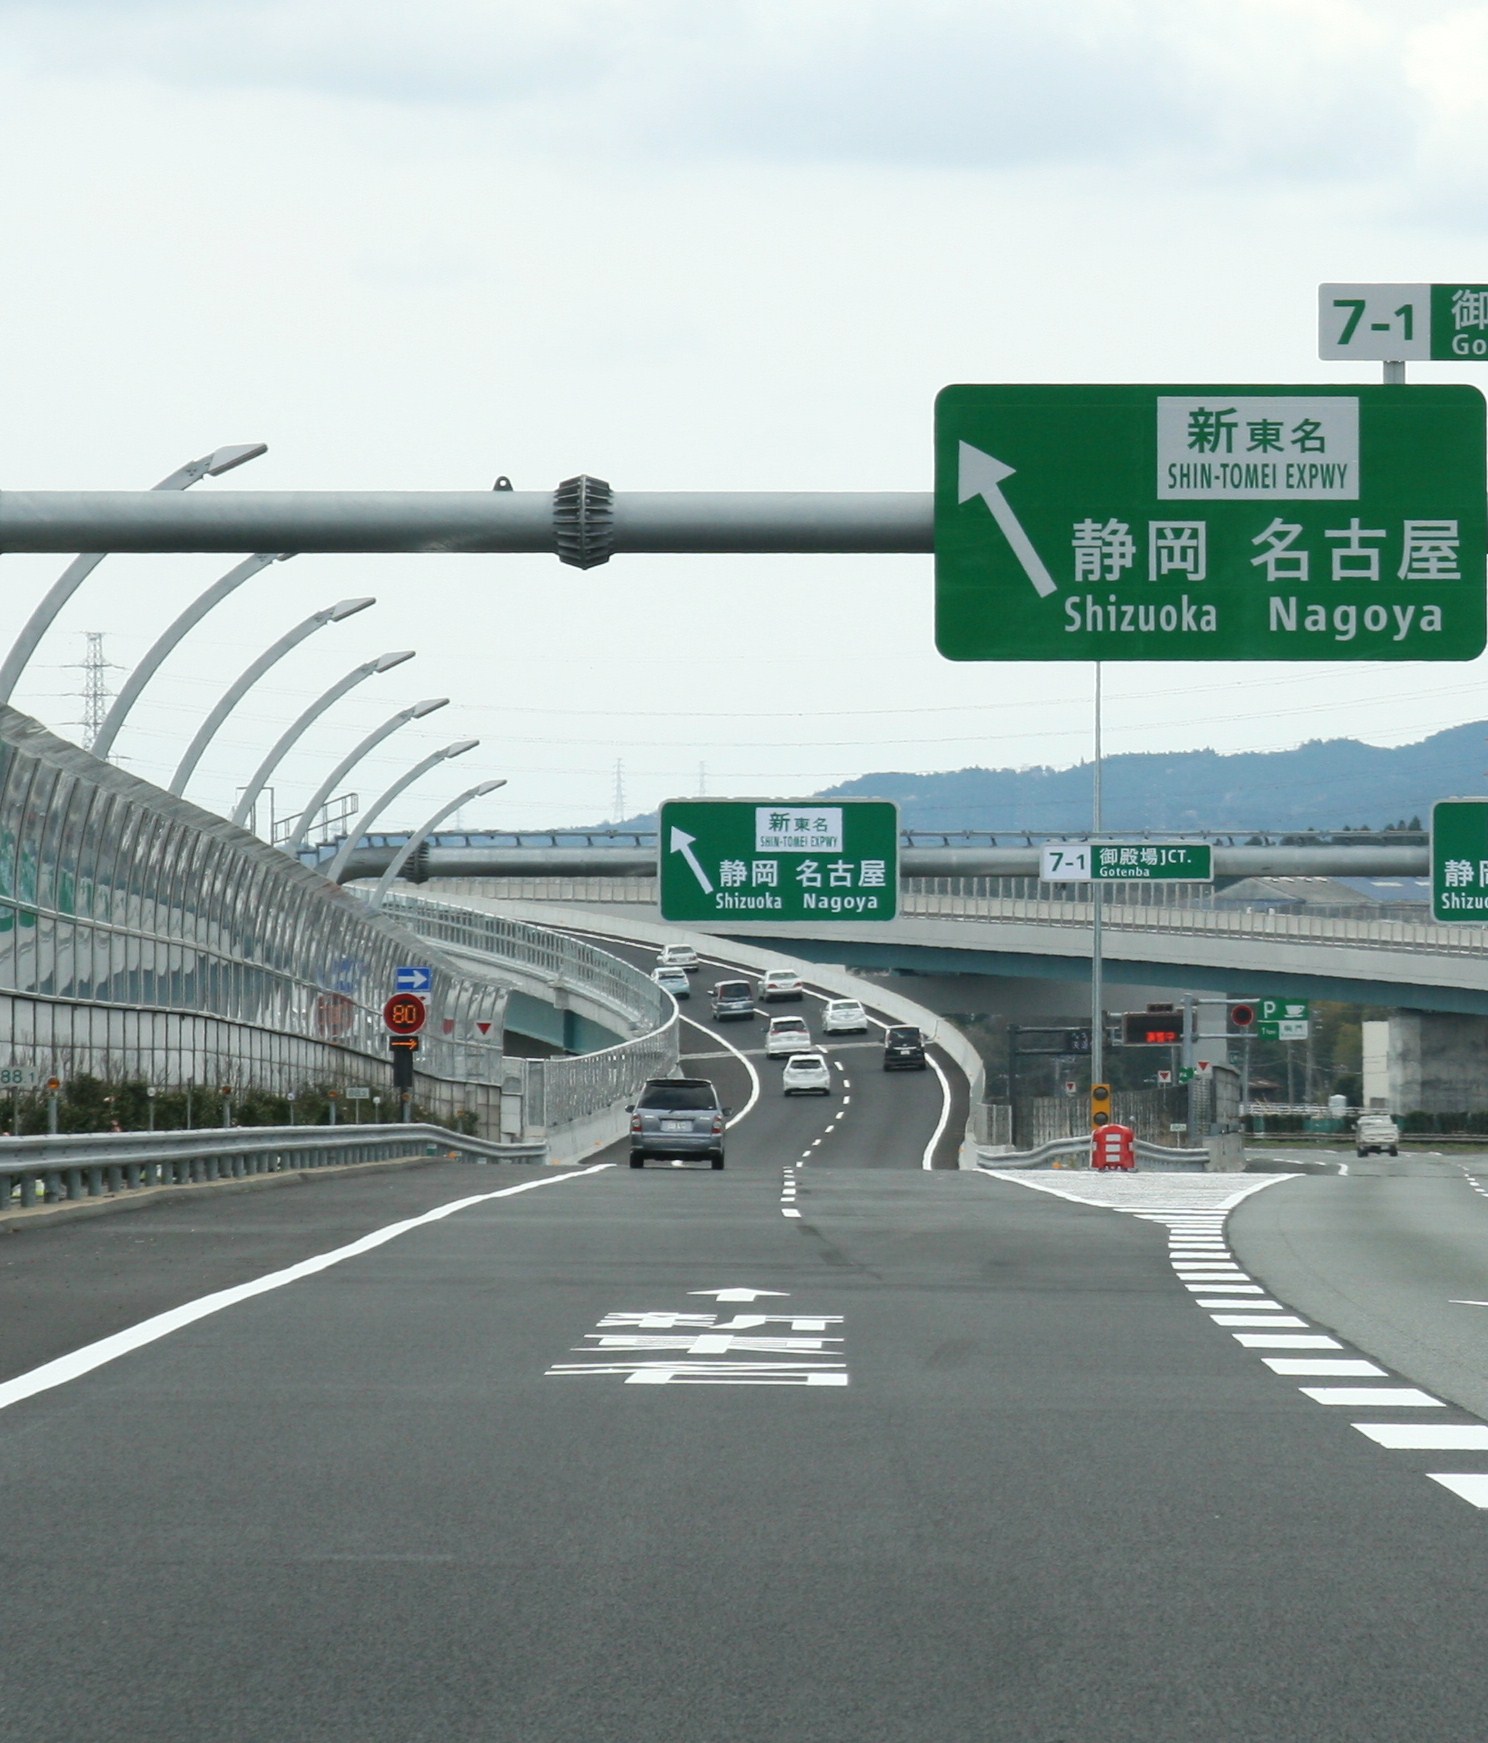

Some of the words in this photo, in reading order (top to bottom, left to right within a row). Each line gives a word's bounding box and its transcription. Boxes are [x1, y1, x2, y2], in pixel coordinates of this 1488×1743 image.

[1332, 299, 1414, 346] 7-1
[1187, 406, 1326, 454] 新東名
[1168, 463, 1277, 490] SHIN-TOMEI
[1285, 463, 1348, 489] EXPWY
[1071, 517, 1207, 583] 静岡
[1249, 516, 1463, 582] 名古屋
[1064, 594, 1218, 634] Shizuoka
[1269, 596, 1443, 642] Nagoya
[768, 812, 829, 833] 新東名
[760, 836, 808, 848] SHIN-TOMEI
[810, 836, 838, 848] EXPWY
[1049, 852, 1086, 872] 7-1
[1099, 847, 1193, 866] 御殿場JCT.
[719, 859, 779, 888] 静岡
[795, 859, 887, 888] 名古屋
[1099, 866, 1150, 878] Gotenba
[715, 892, 783, 910] Shizuoka
[803, 893, 878, 913] Nagoya
[393, 1004, 417, 1024] 80
[1263, 1001, 1276, 1019] P
